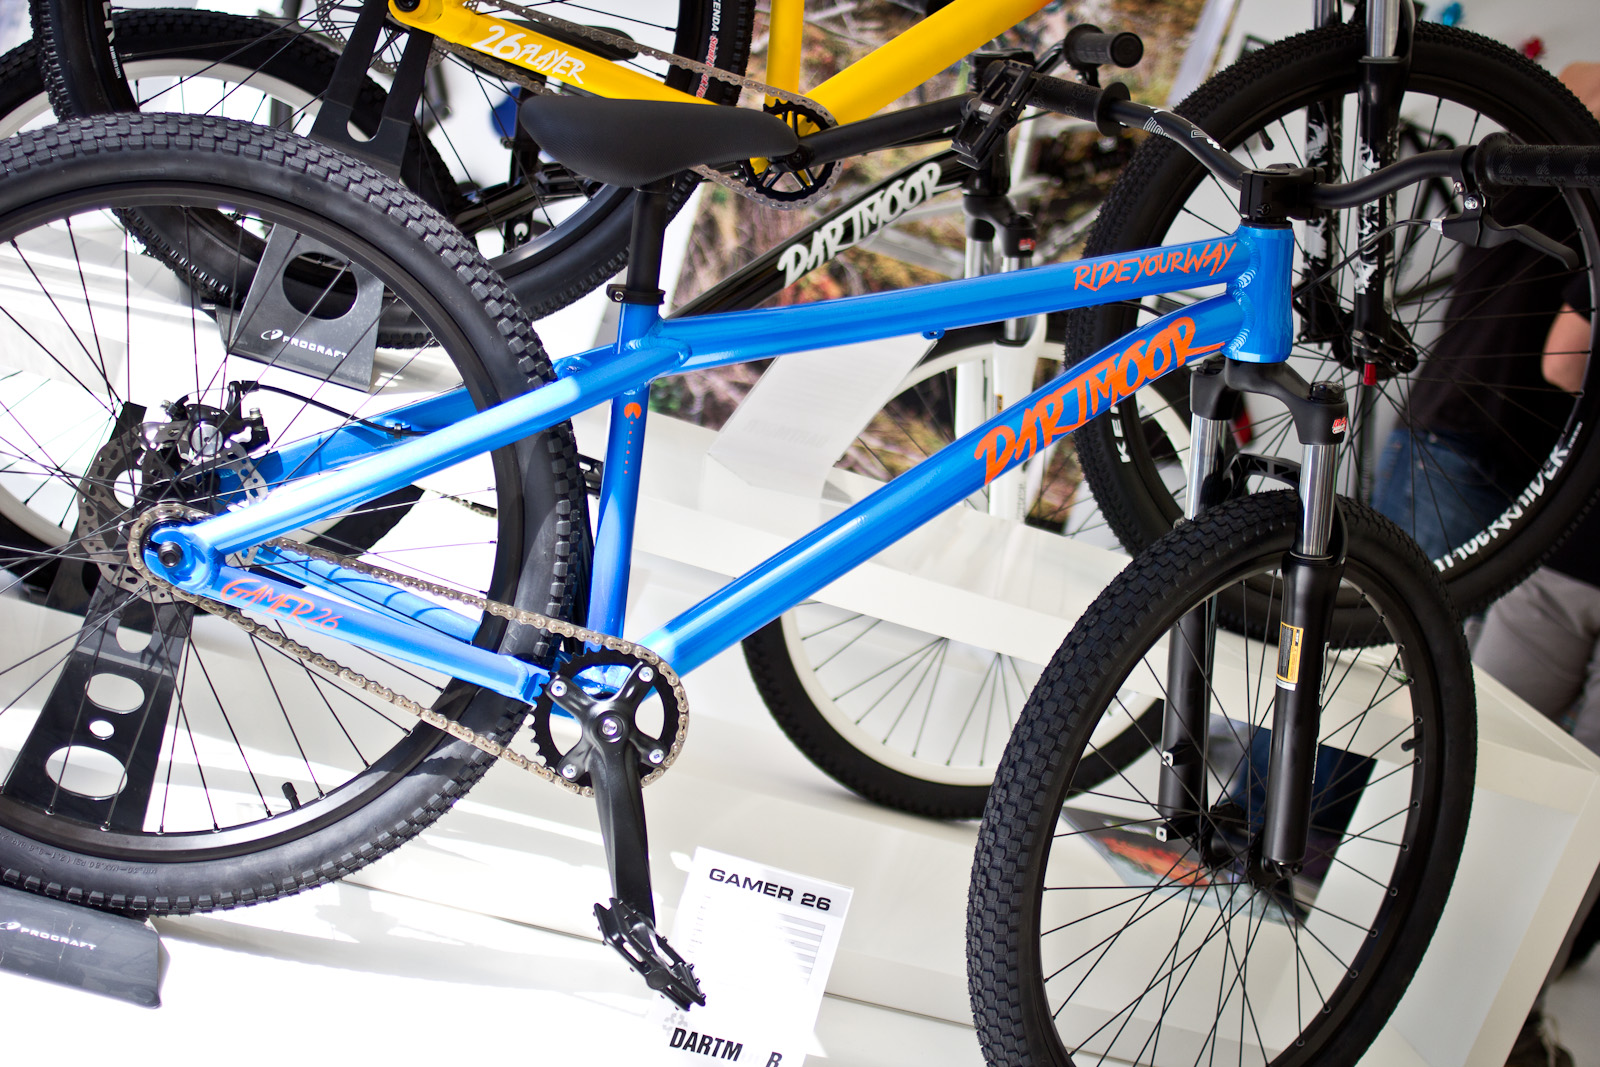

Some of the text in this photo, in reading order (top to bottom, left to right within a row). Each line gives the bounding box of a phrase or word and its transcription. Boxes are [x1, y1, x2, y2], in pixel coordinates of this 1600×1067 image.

[711, 0, 722, 32] ENDA
[777, 162, 963, 289] DARTMOOR
[282, 335, 347, 359] PROCRAFT
[974, 316, 1226, 486] DARTMOOR
[709, 868, 832, 912] GAMER 26
[20, 926, 97, 951] PROCRAFT
[669, 1027, 783, 1067] DARTMR
